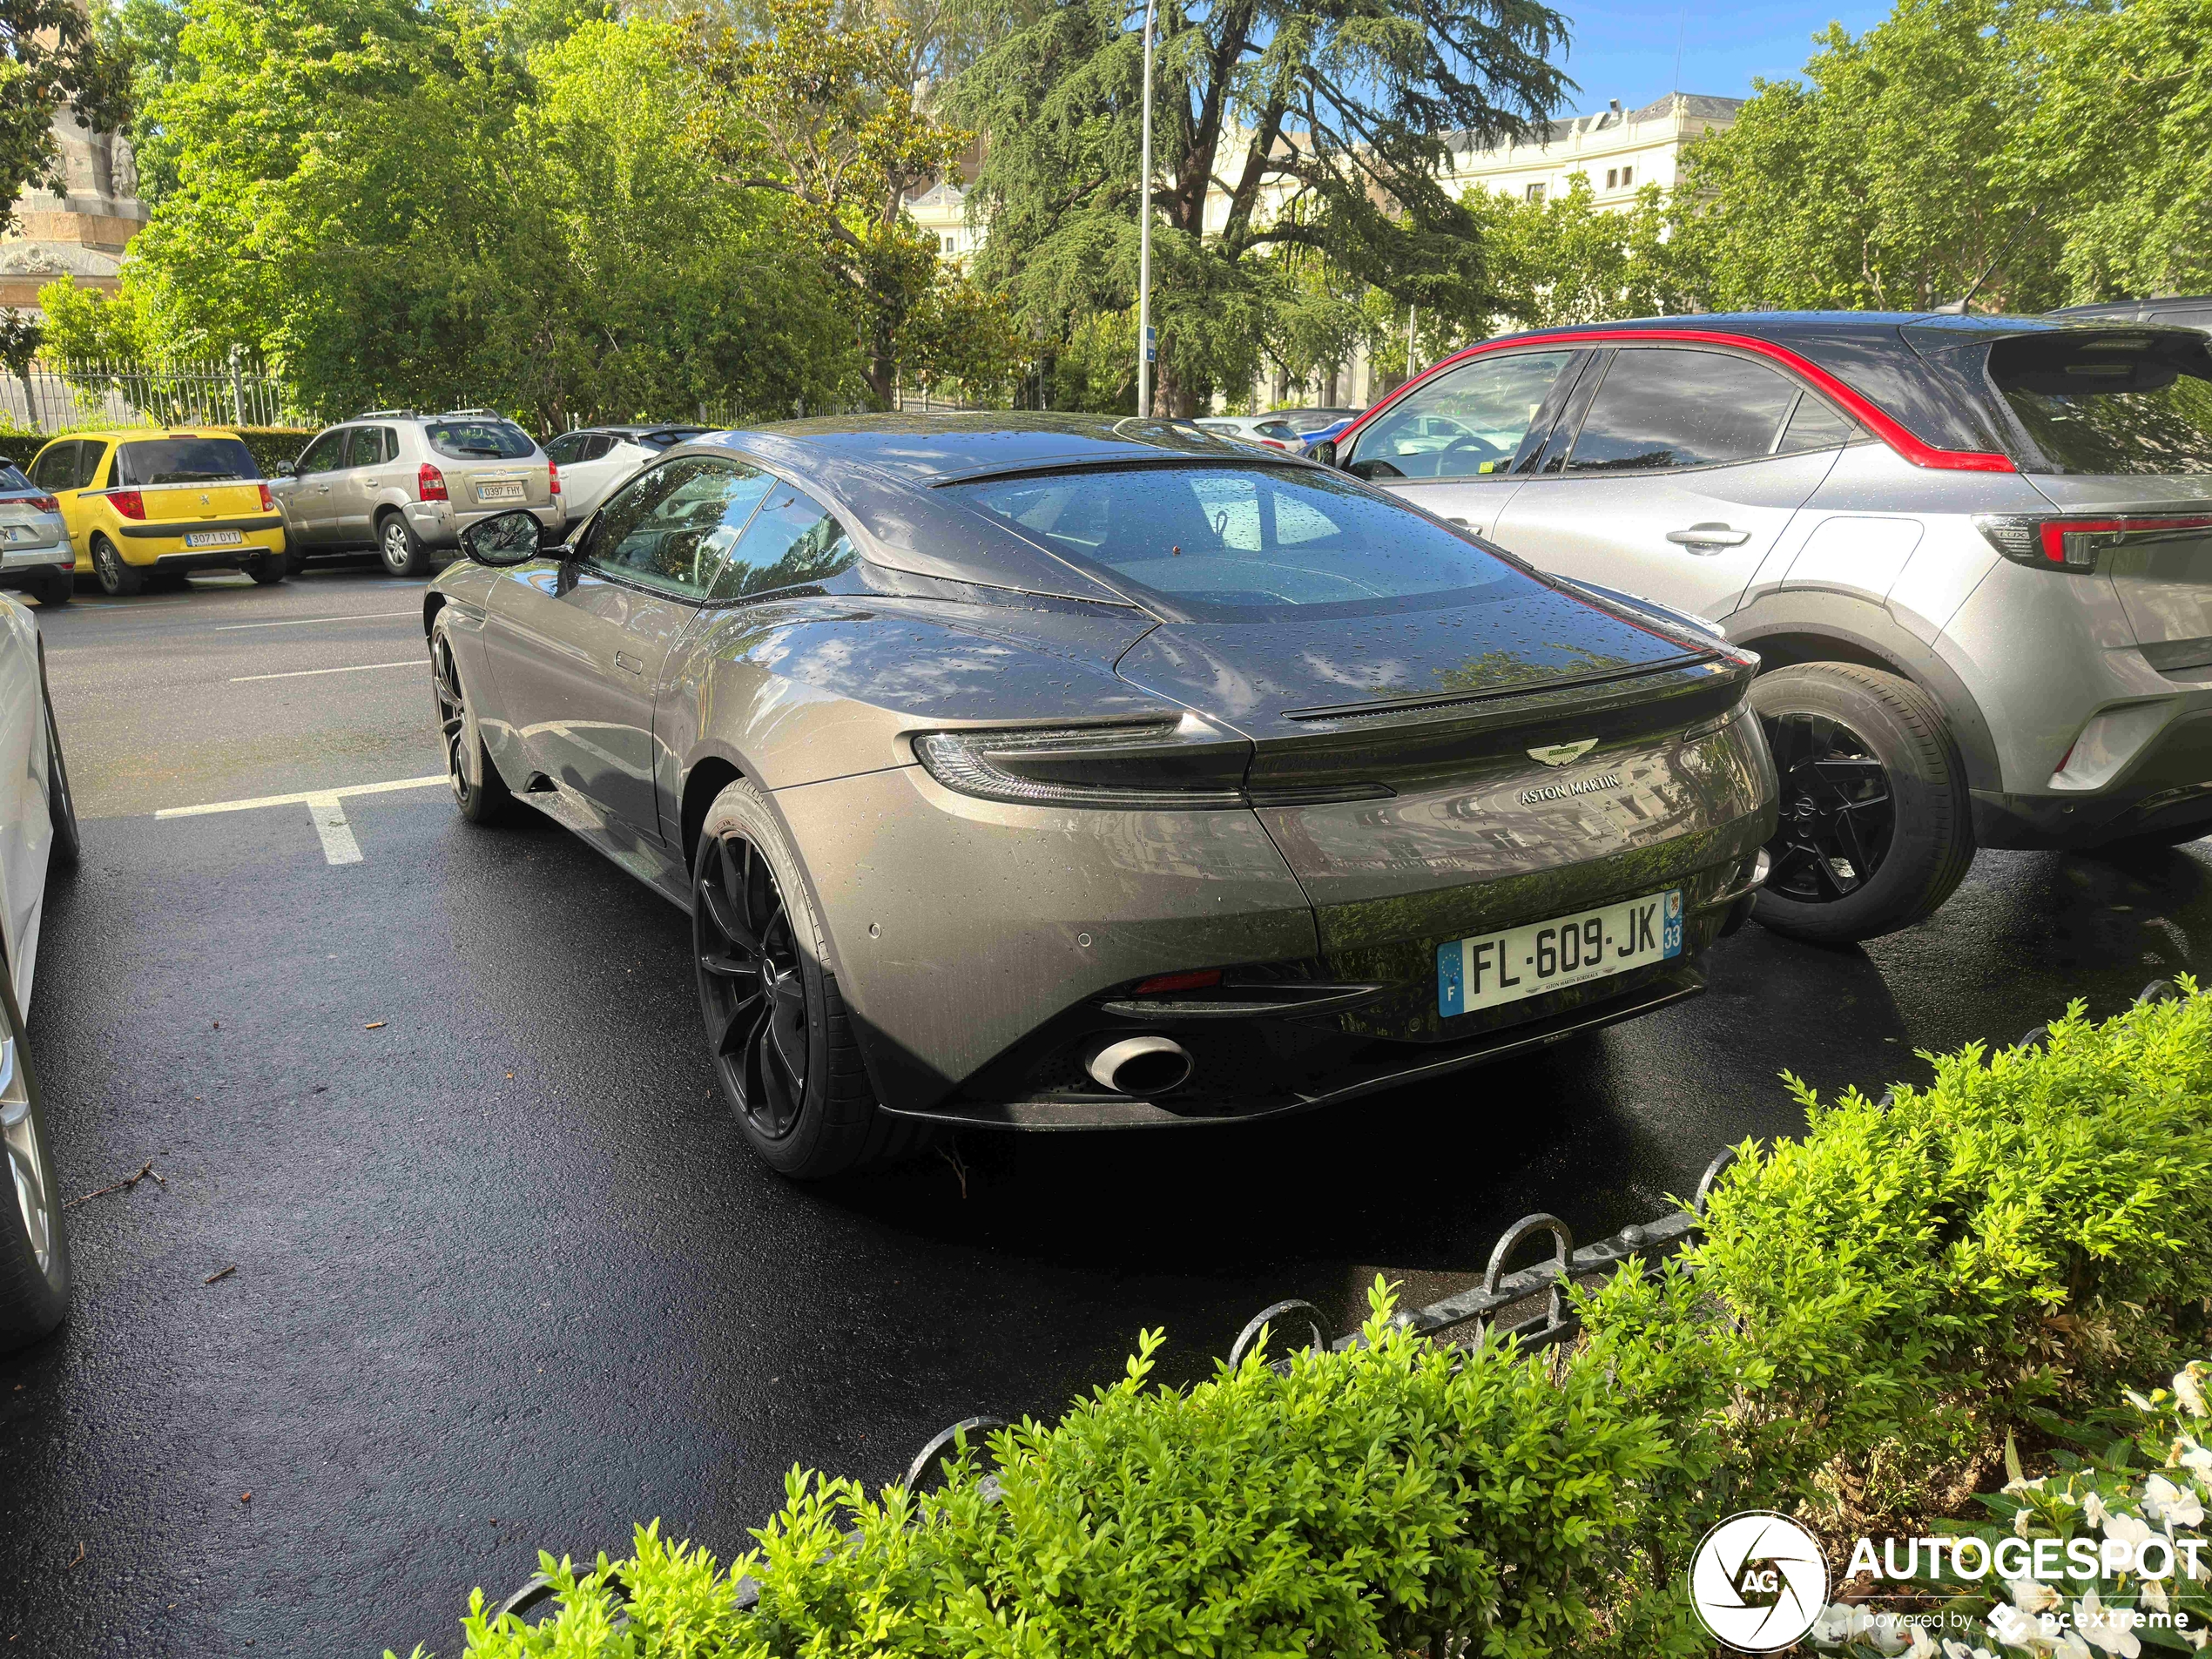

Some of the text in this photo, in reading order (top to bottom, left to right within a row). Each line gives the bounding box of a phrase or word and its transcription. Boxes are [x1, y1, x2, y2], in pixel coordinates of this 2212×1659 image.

[485, 486, 521, 496] 0397 FHY
[192, 532, 238, 543] 3071 DYT
[1521, 774, 1619, 805] ASTON MARTIN
[1664, 924, 1681, 949] 33
[1545, 973, 1599, 990] ASTON MARTIN BORDEAUX
[1447, 986, 1455, 1001] F
